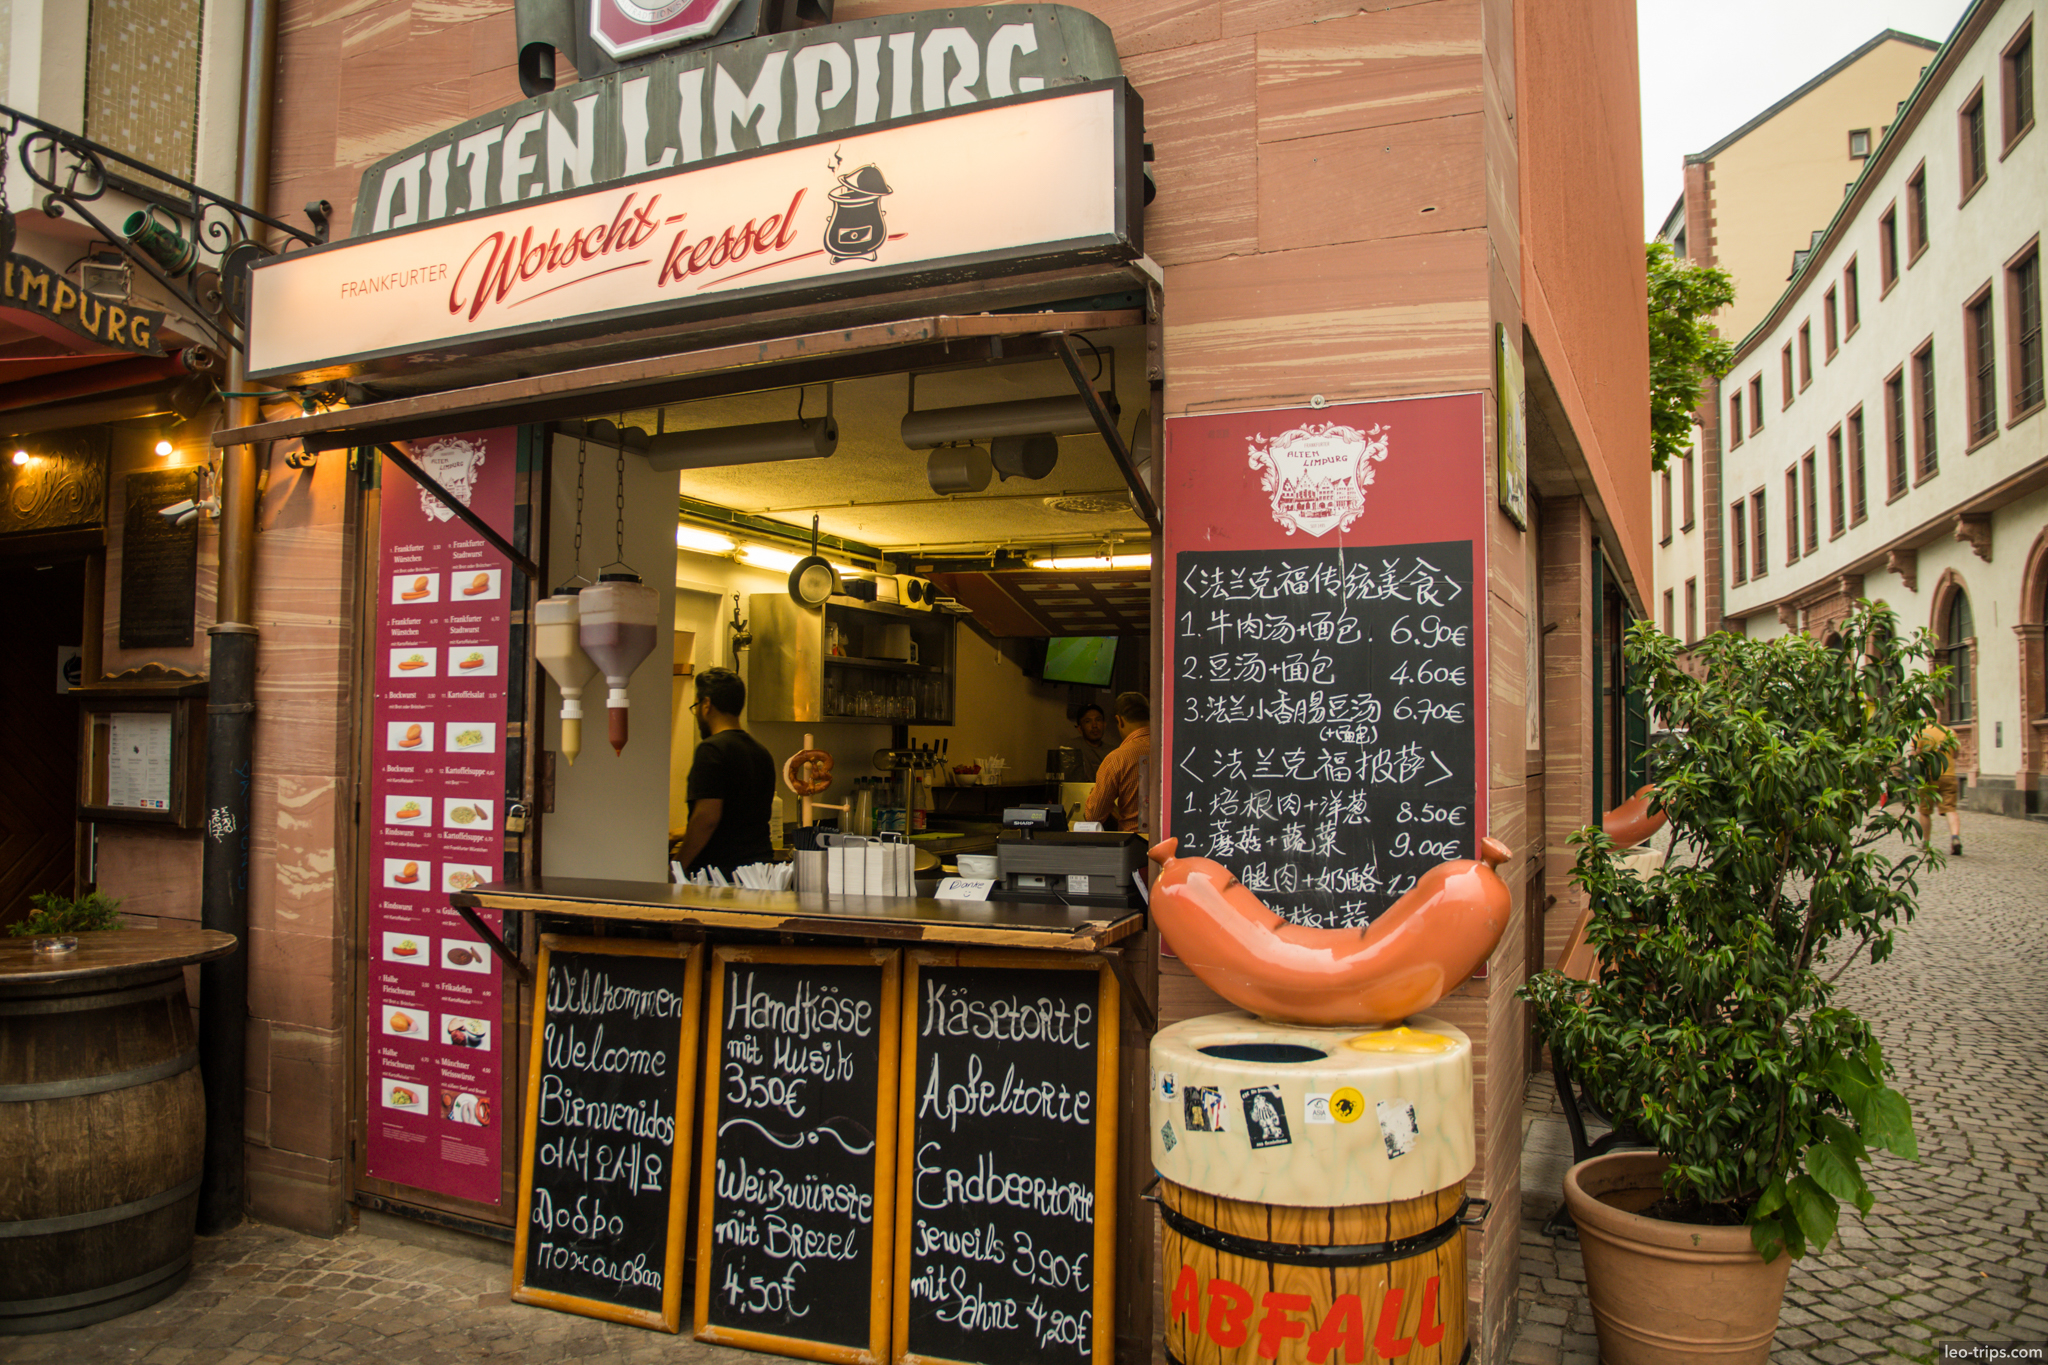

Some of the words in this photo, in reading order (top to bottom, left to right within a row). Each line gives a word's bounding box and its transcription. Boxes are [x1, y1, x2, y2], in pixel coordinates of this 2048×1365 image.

[372, 93, 600, 234] ALTEN
[621, 22, 1045, 177] LIMPURG
[657, 187, 809, 287] kessel
[341, 263, 448, 299] FRANKFURTER
[448, 191, 688, 322] Worscht-
[1303, 455, 1348, 467] LIMPURG
[394, 545, 424, 553] Frankfurter
[453, 540, 485, 549] Frankfurter
[394, 555, 422, 563] Würstchen
[453, 551, 483, 559] Stadtwurst
[391, 618, 422, 626] Frankfurter
[450, 615, 482, 623] Frankfurter
[391, 628, 419, 636] Würstchen
[450, 626, 480, 634] Stadtwurst
[1391, 615, 1468, 648] 6.90€
[1390, 659, 1466, 686] 4.60€
[389, 691, 417, 699] Bockwurst
[447, 691, 485, 699] Kartoffelsalat
[1393, 696, 1466, 724] 6.70€
[387, 765, 414, 773] Bockwurst
[445, 766, 486, 777] Kartoffelsuppe
[1396, 802, 1466, 826] 8.50€
[385, 828, 414, 837] Rindswurst
[444, 831, 484, 843] Kartoffelsuppe
[1389, 833, 1462, 860] 9.00€
[949, 880, 985, 890] Danke
[1224, 860, 1383, 893] 腿肉+奶酪
[383, 901, 413, 911] Rindswurst
[383, 974, 398, 984] Halbe
[442, 982, 472, 994] Frikadellen
[383, 985, 416, 996] Fleischwurst
[547, 965, 683, 1020] Willkommen
[727, 971, 872, 1040] Handkäse
[922, 979, 1092, 1050] Käsetorte
[382, 1047, 398, 1057] Halbe
[544, 1022, 666, 1077] Welcome
[727, 1034, 763, 1066] mit
[773, 1036, 853, 1082] Musik
[382, 1058, 415, 1070] Fleischwurst
[441, 1058, 470, 1070] Münchner
[725, 1062, 807, 1118] 3,50€
[919, 1052, 1090, 1133] Apfeltorte
[540, 1074, 675, 1146] Bienvenidos
[540, 1136, 662, 1196] 어서오세요
[916, 1141, 1094, 1224] Erdbeertorte
[715, 1209, 759, 1246] mit
[763, 1213, 858, 1262] Brezel
[916, 1219, 1006, 1264] jeweils
[1013, 1230, 1090, 1292] 3,90€
[911, 1264, 950, 1302] mit
[936, 1265, 1019, 1332] Sahne
[1026, 1294, 1092, 1355] 4,20€
[1171, 1263, 1445, 1364] ABFALL
